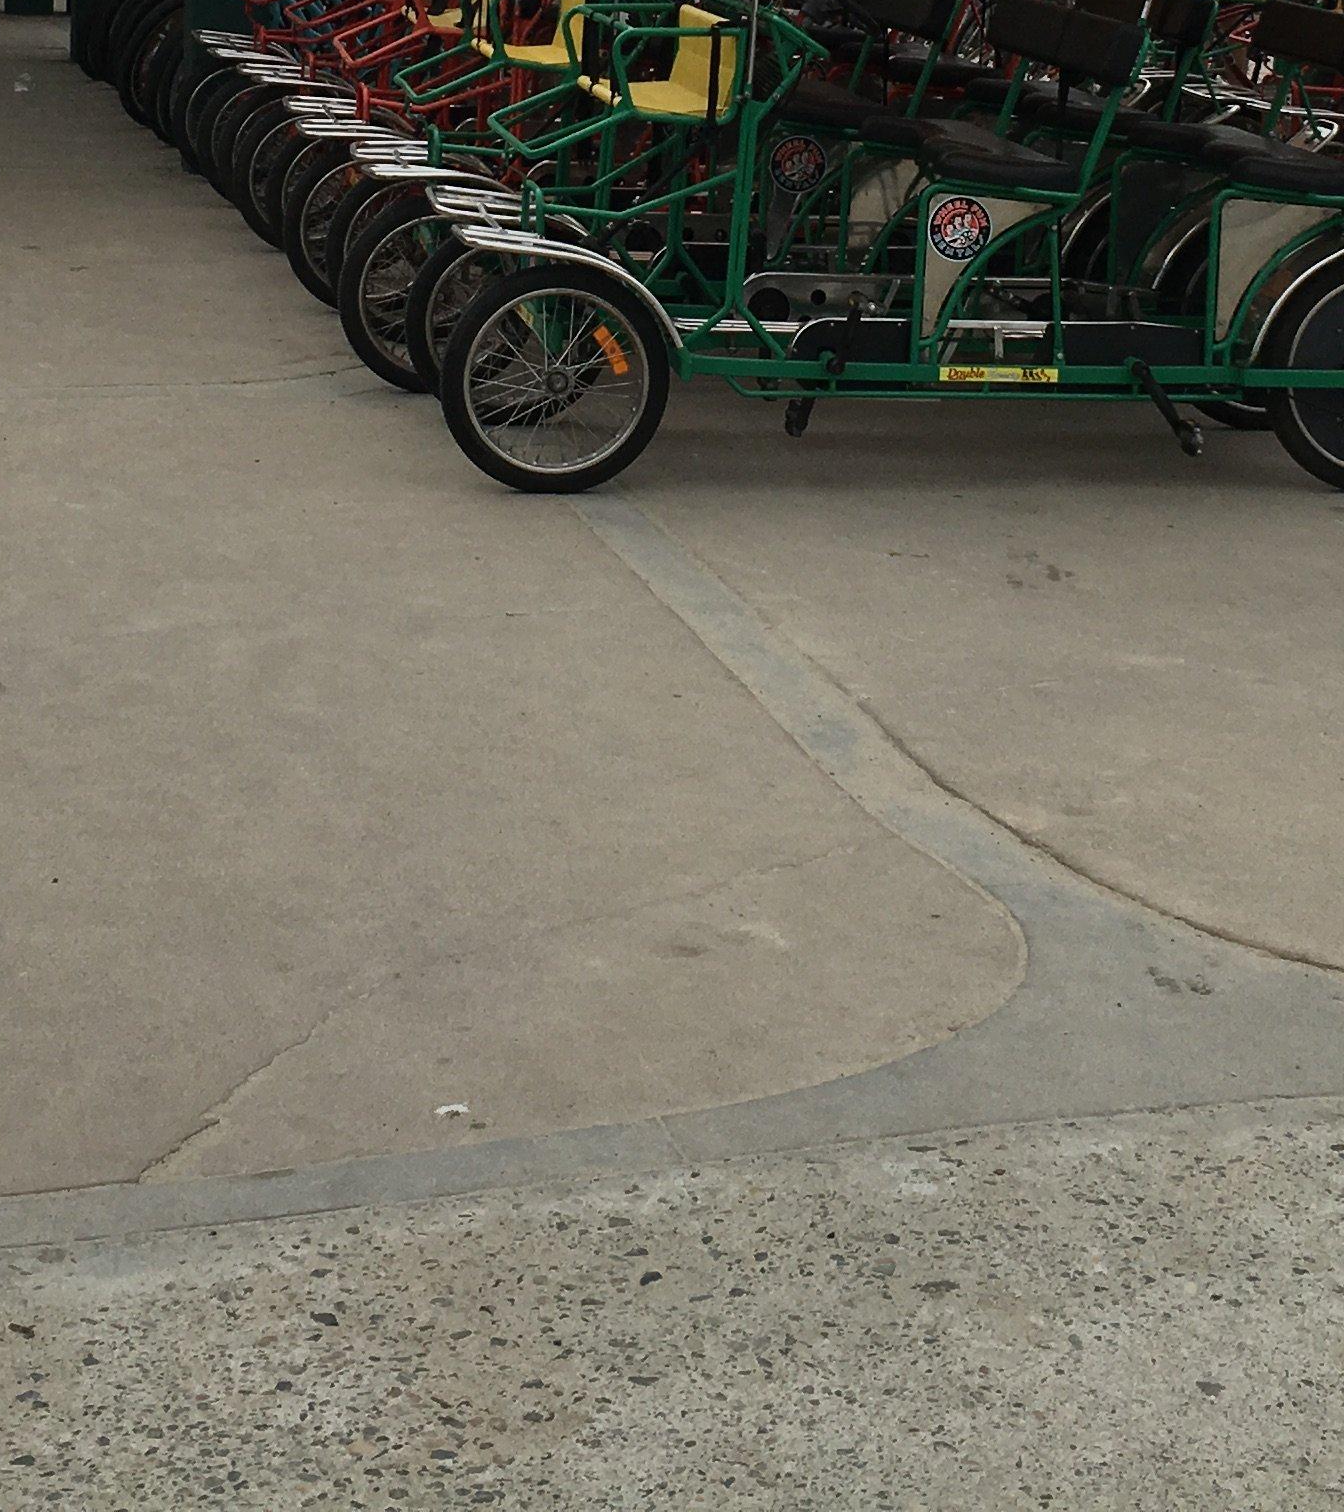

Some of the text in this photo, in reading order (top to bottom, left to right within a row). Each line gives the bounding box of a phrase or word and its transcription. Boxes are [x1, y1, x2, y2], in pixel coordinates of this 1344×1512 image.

[933, 199, 988, 227] WHEEL FUN
[932, 232, 984, 258] RENTALS
